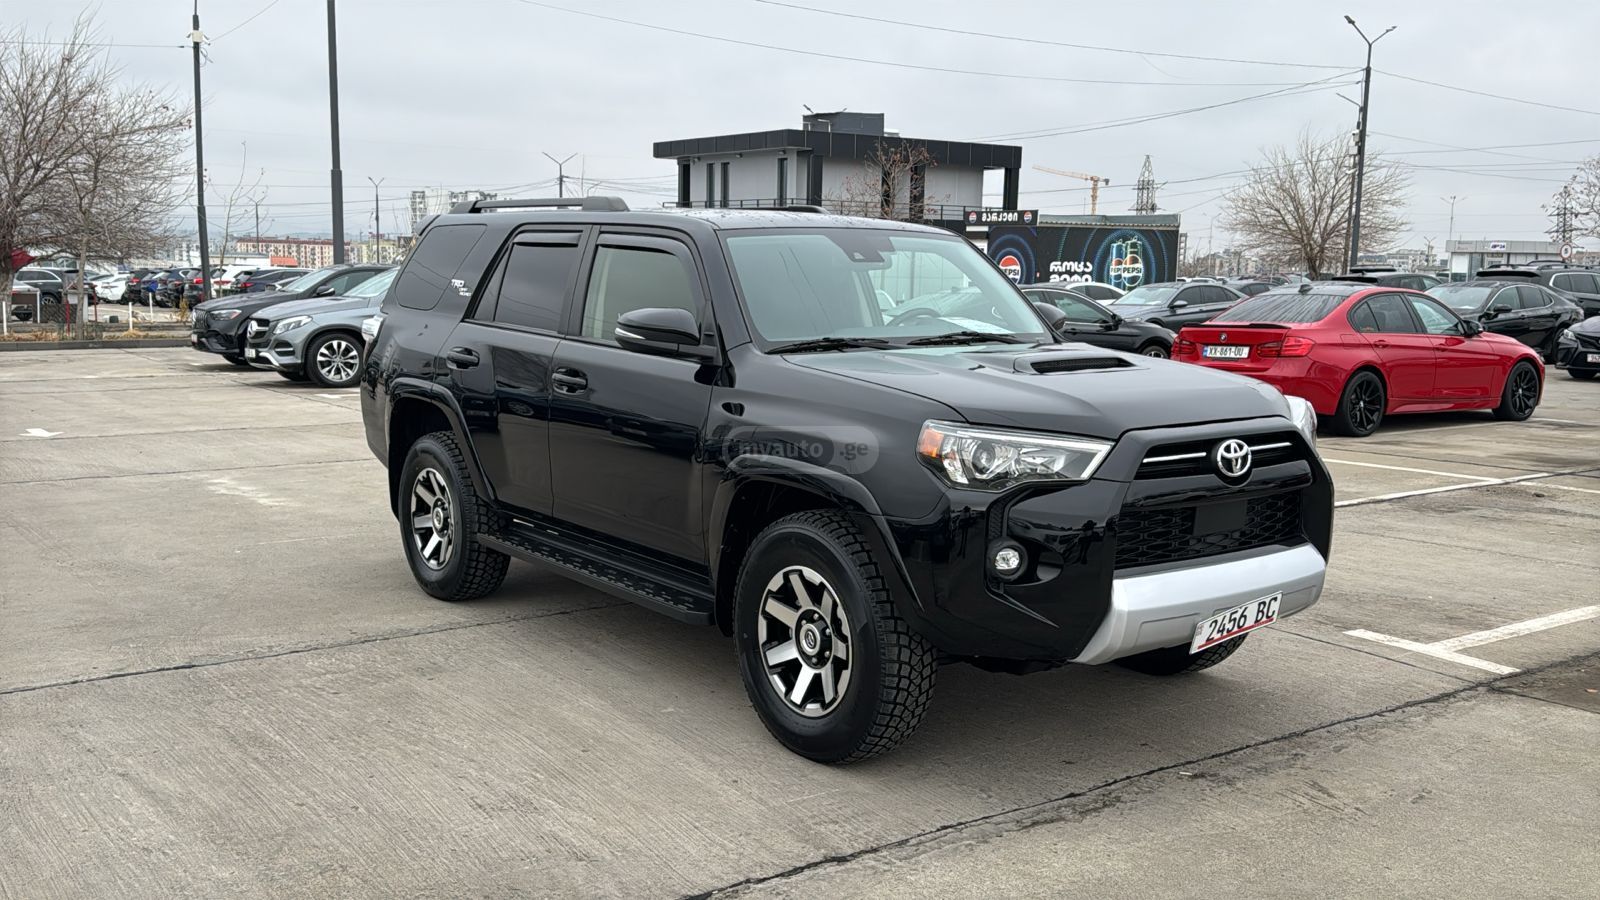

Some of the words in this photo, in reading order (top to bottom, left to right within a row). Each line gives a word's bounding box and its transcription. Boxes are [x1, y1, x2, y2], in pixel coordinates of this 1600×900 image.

[982, 212, 1018, 222] მარკეტი
[1003, 268, 1020, 276] EPSI
[1122, 266, 1142, 274] PEPSI
[1205, 606, 1248, 642] 2456
[1254, 596, 1278, 624] BC
